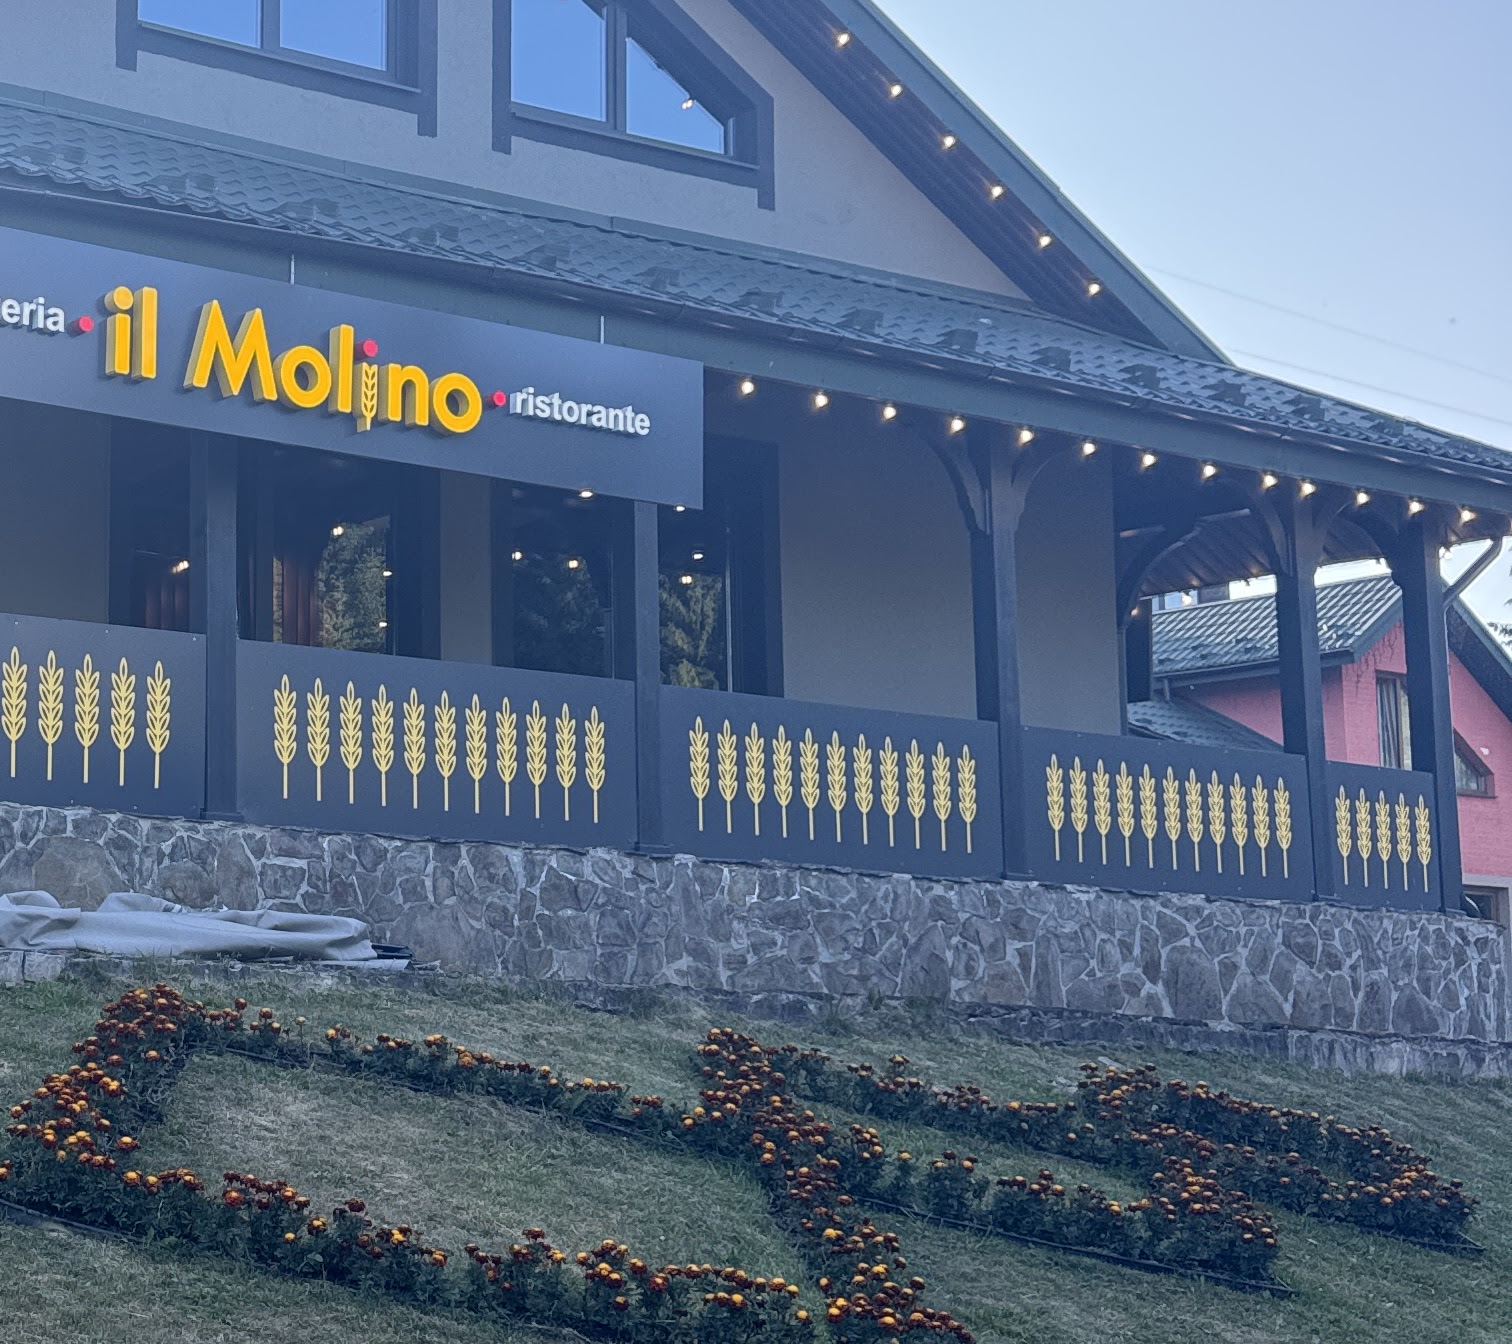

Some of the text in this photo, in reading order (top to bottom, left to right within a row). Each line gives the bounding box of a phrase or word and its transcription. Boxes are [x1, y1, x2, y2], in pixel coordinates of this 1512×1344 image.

[104, 285, 158, 379] il
[183, 299, 483, 434] Molino
[509, 386, 651, 436] ristorante
